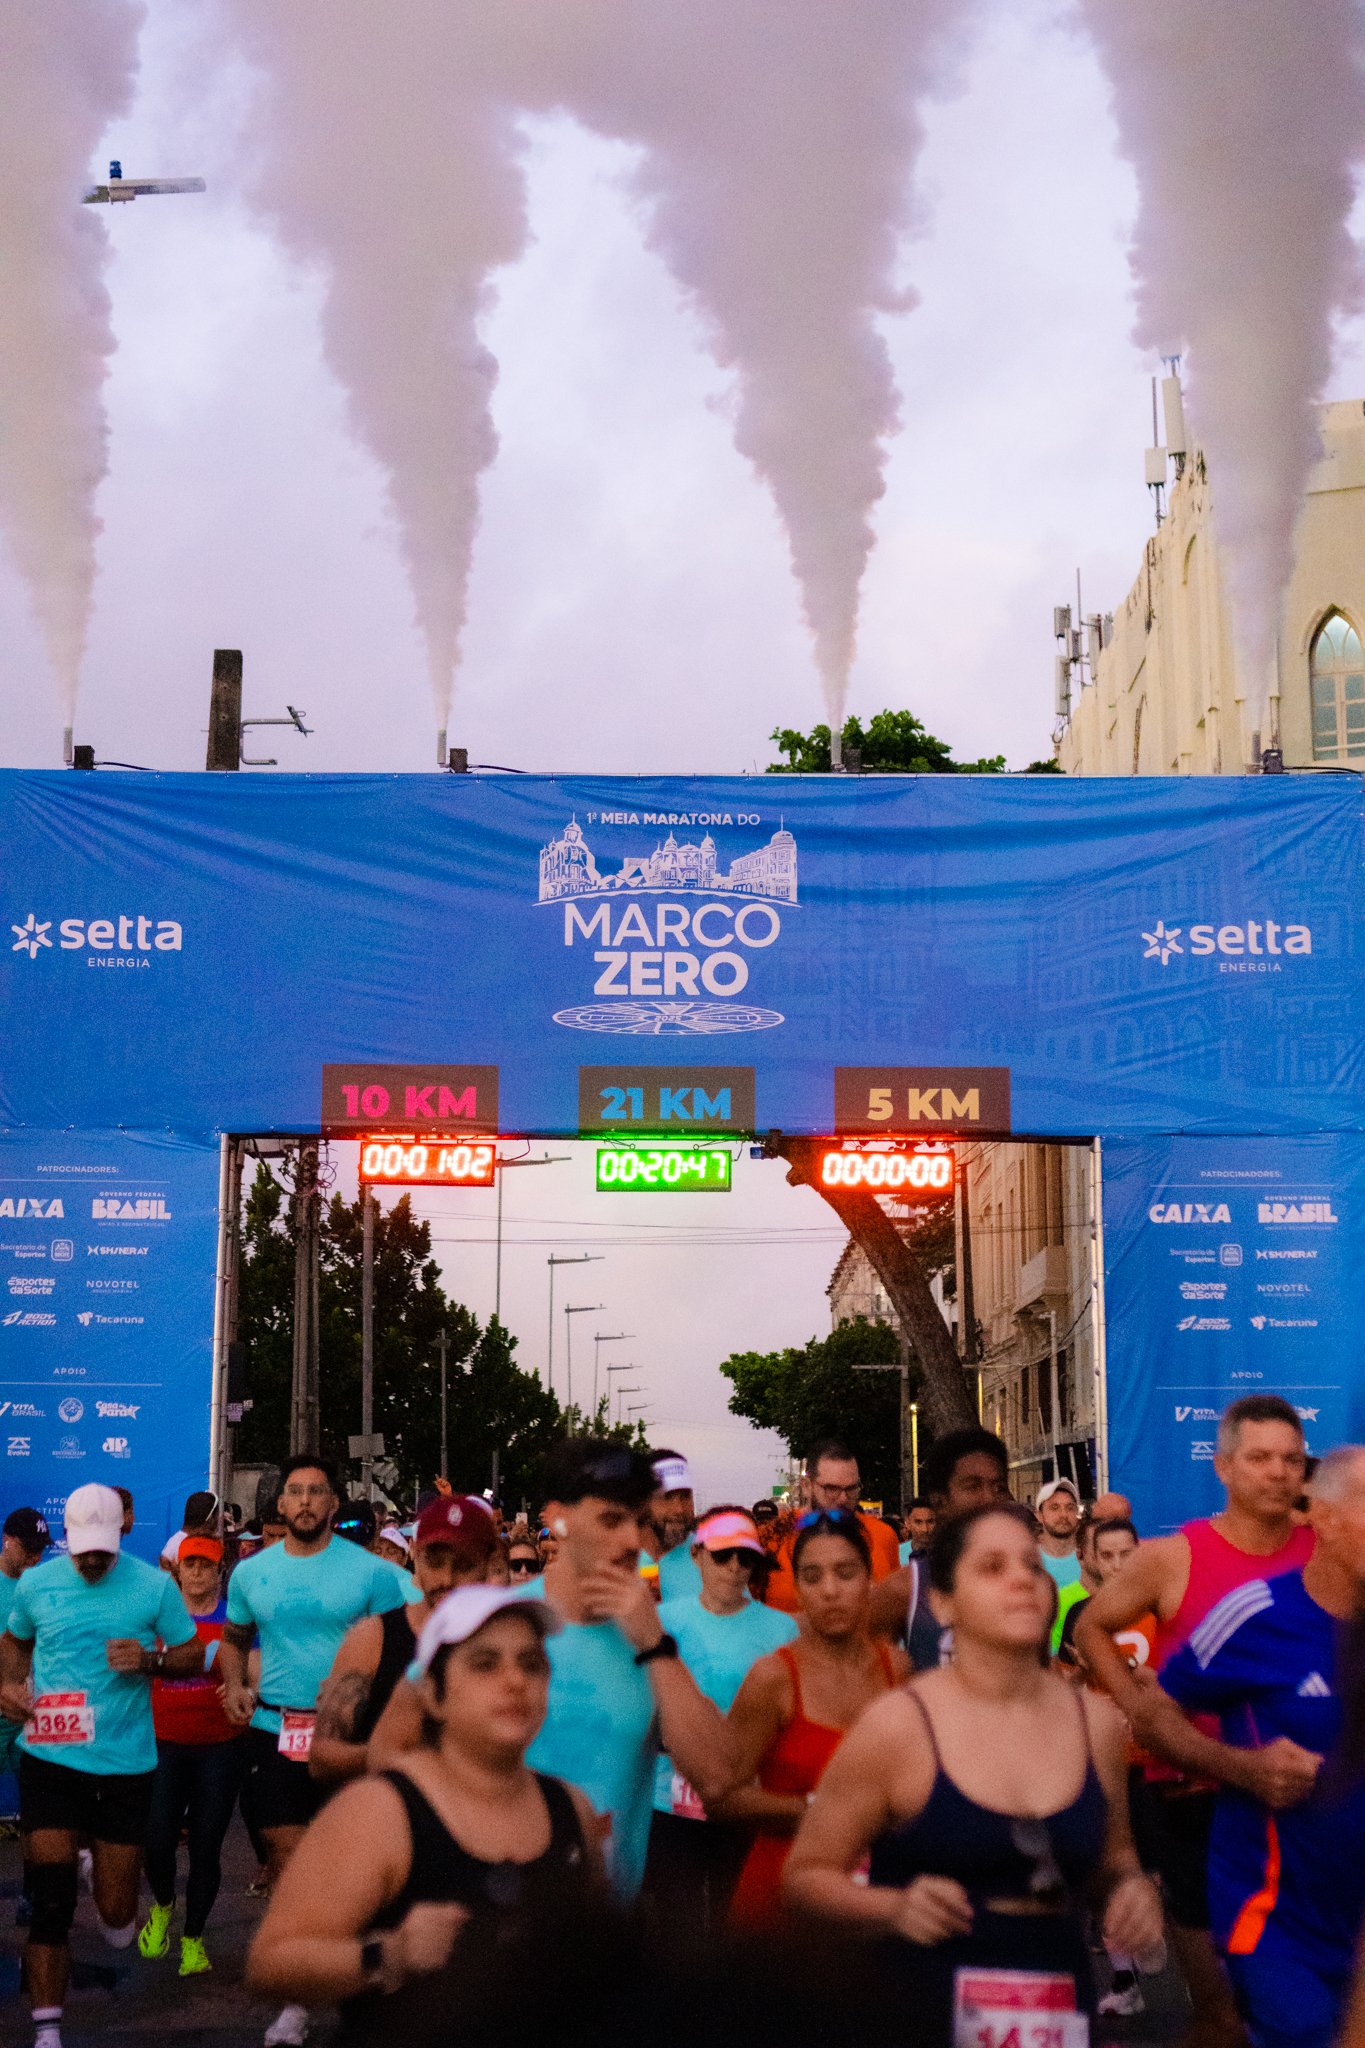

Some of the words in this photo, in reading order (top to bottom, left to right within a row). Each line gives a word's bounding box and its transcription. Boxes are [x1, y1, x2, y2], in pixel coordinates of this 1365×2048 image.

[601, 812, 640, 825] MEIA
[643, 812, 733, 825] MARATONA
[737, 813, 761, 826] DO
[60, 915, 183, 951] setta
[564, 903, 780, 948] MARCO
[1189, 920, 1312, 955] setta
[88, 957, 151, 968] ENERGIA
[1219, 963, 1282, 973] ENERGIA
[593, 951, 749, 997] ZERO
[341, 1085, 390, 1118] 10
[405, 1086, 477, 1118] KM
[600, 1087, 643, 1120] 21
[660, 1087, 731, 1120] KM
[867, 1088, 894, 1121] 5
[908, 1088, 980, 1121] KM
[36, 1165, 120, 1173] PATROCINADORES:
[362, 1144, 492, 1178] 00:01:02
[599, 1151, 727, 1183] 00:20:47
[822, 1153, 951, 1188] 00:00:00
[1200, 1170, 1282, 1178] PATROCINADORES:
[0, 1198, 65, 1218] AIXA
[91, 1199, 172, 1220] BRASIL
[1149, 1203, 1232, 1223] CAIXA
[1257, 1203, 1338, 1223] BRASIL
[7, 1276, 56, 1286] Esportes
[86, 1280, 140, 1289] NOVOTEL
[95, 1314, 145, 1324] Tacaruna
[1269, 1318, 1319, 1327] Tacaruna
[53, 1367, 87, 1375] APOIO
[1231, 1371, 1264, 1379] APOIO
[34, 1714, 81, 1733] 1362
